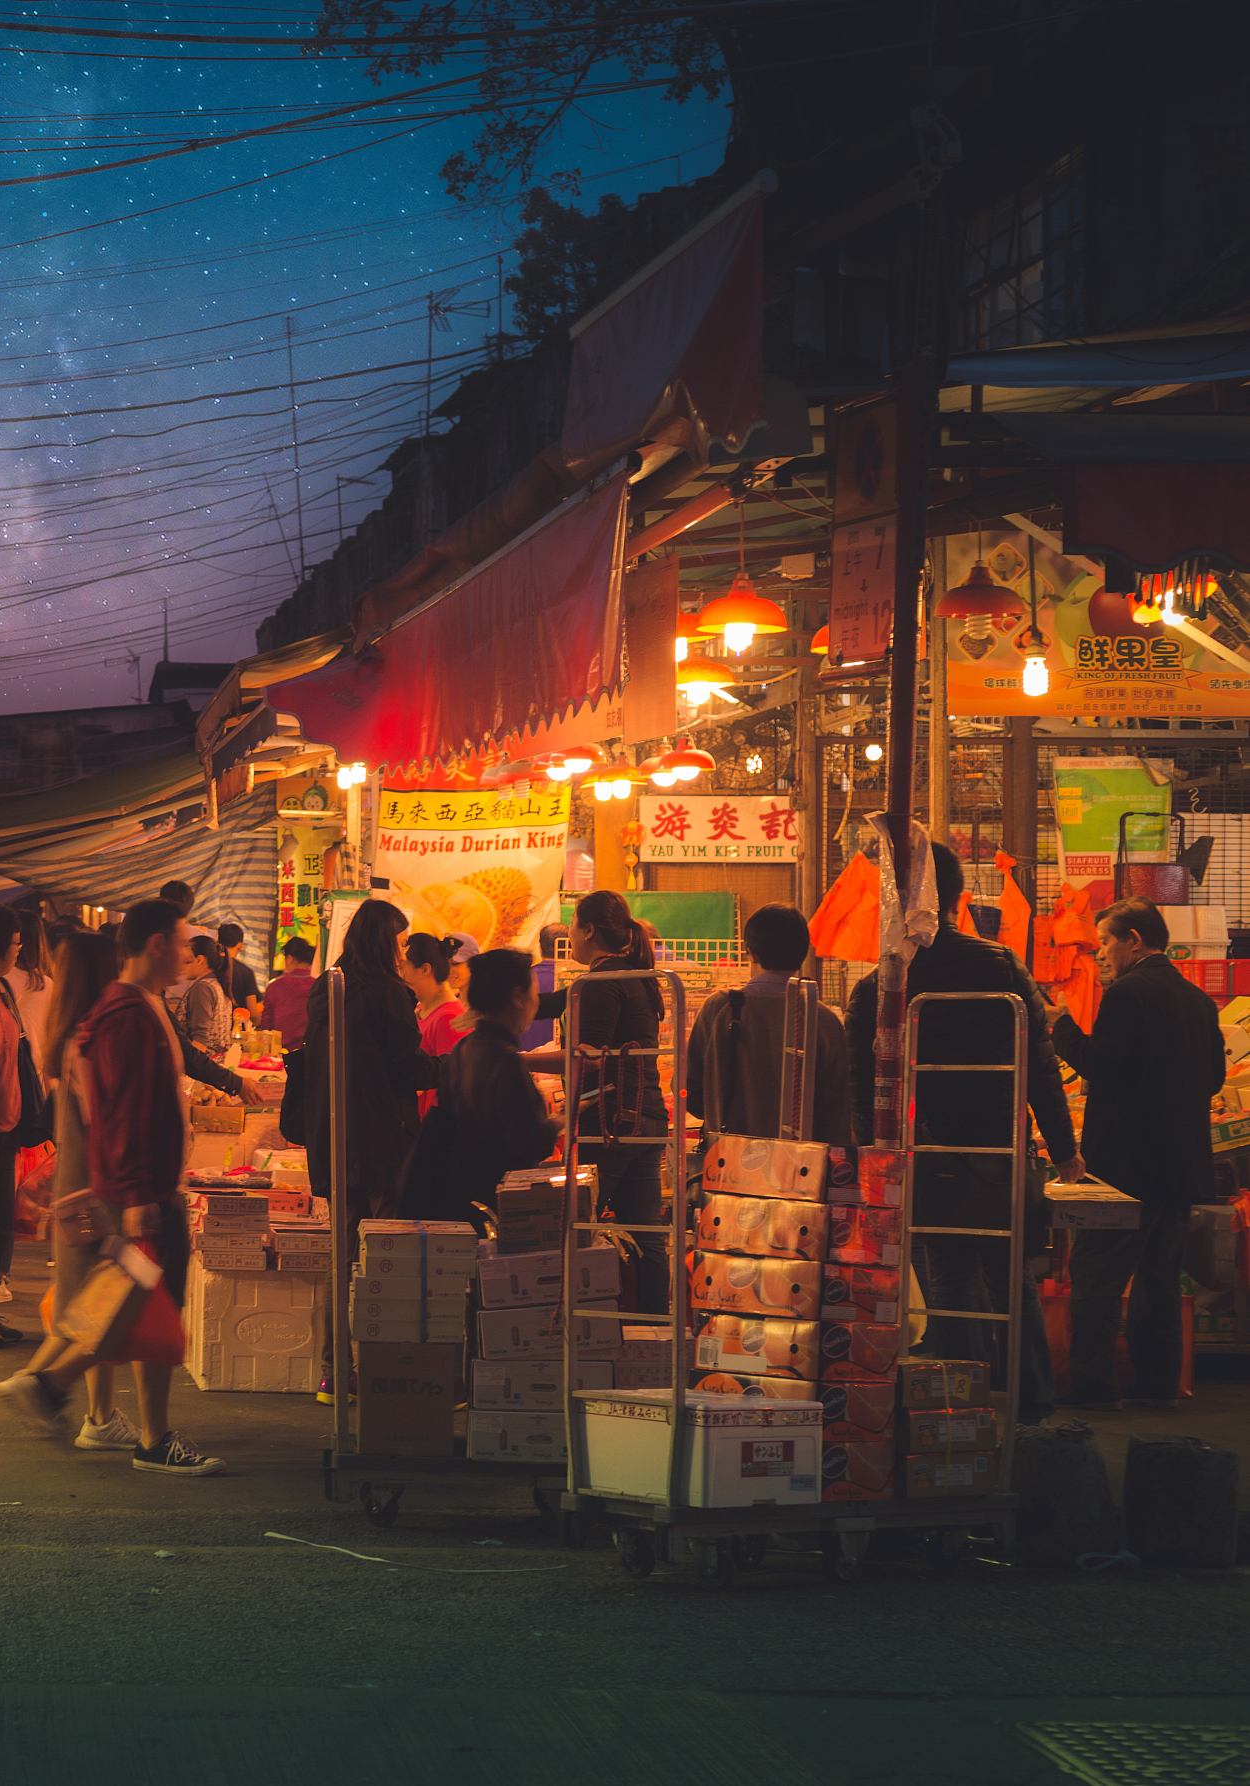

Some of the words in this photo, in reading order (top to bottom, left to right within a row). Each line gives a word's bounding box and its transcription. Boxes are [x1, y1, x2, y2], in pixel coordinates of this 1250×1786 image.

[874, 526, 887, 570] 7
[842, 551, 862, 576] 上午
[834, 599, 869, 622] midnight
[872, 599, 892, 645] 12
[841, 625, 860, 649] 午夜
[1077, 637, 1181, 669] 鮮果皇
[383, 799, 564, 824] 馬來西亞貓山王
[651, 802, 797, 841] 游炎記
[1061, 807, 1078, 816] FRUIT
[379, 834, 455, 856] Malaysia
[461, 834, 520, 853] Durian
[526, 831, 564, 848] King
[649, 845, 674, 857] YAU
[681, 845, 707, 857] YIM
[747, 845, 785, 857] FRUIT
[824, 1334, 850, 1350] Sunkist
[370, 1377, 443, 1396] 長崎びわ
[956, 1379, 966, 1394] 8
[754, 1444, 783, 1459] サンふじ
